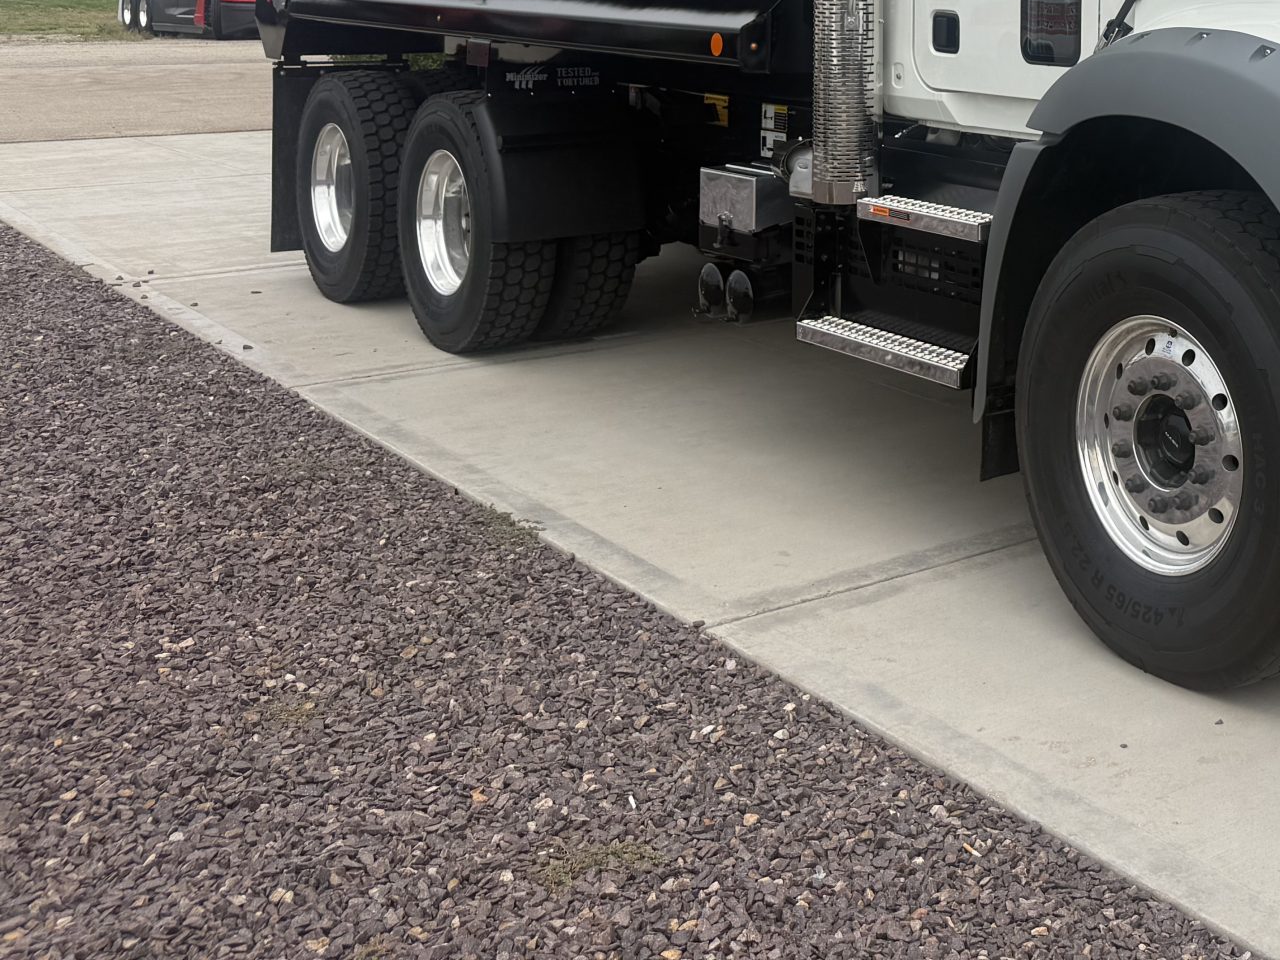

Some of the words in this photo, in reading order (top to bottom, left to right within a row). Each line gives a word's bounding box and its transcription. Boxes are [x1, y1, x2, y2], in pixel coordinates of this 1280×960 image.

[556, 66, 592, 77] TESTED
[1061, 521, 1092, 572] 22.5
[1090, 568, 1105, 589] R
[1105, 583, 1164, 626] 425/65
